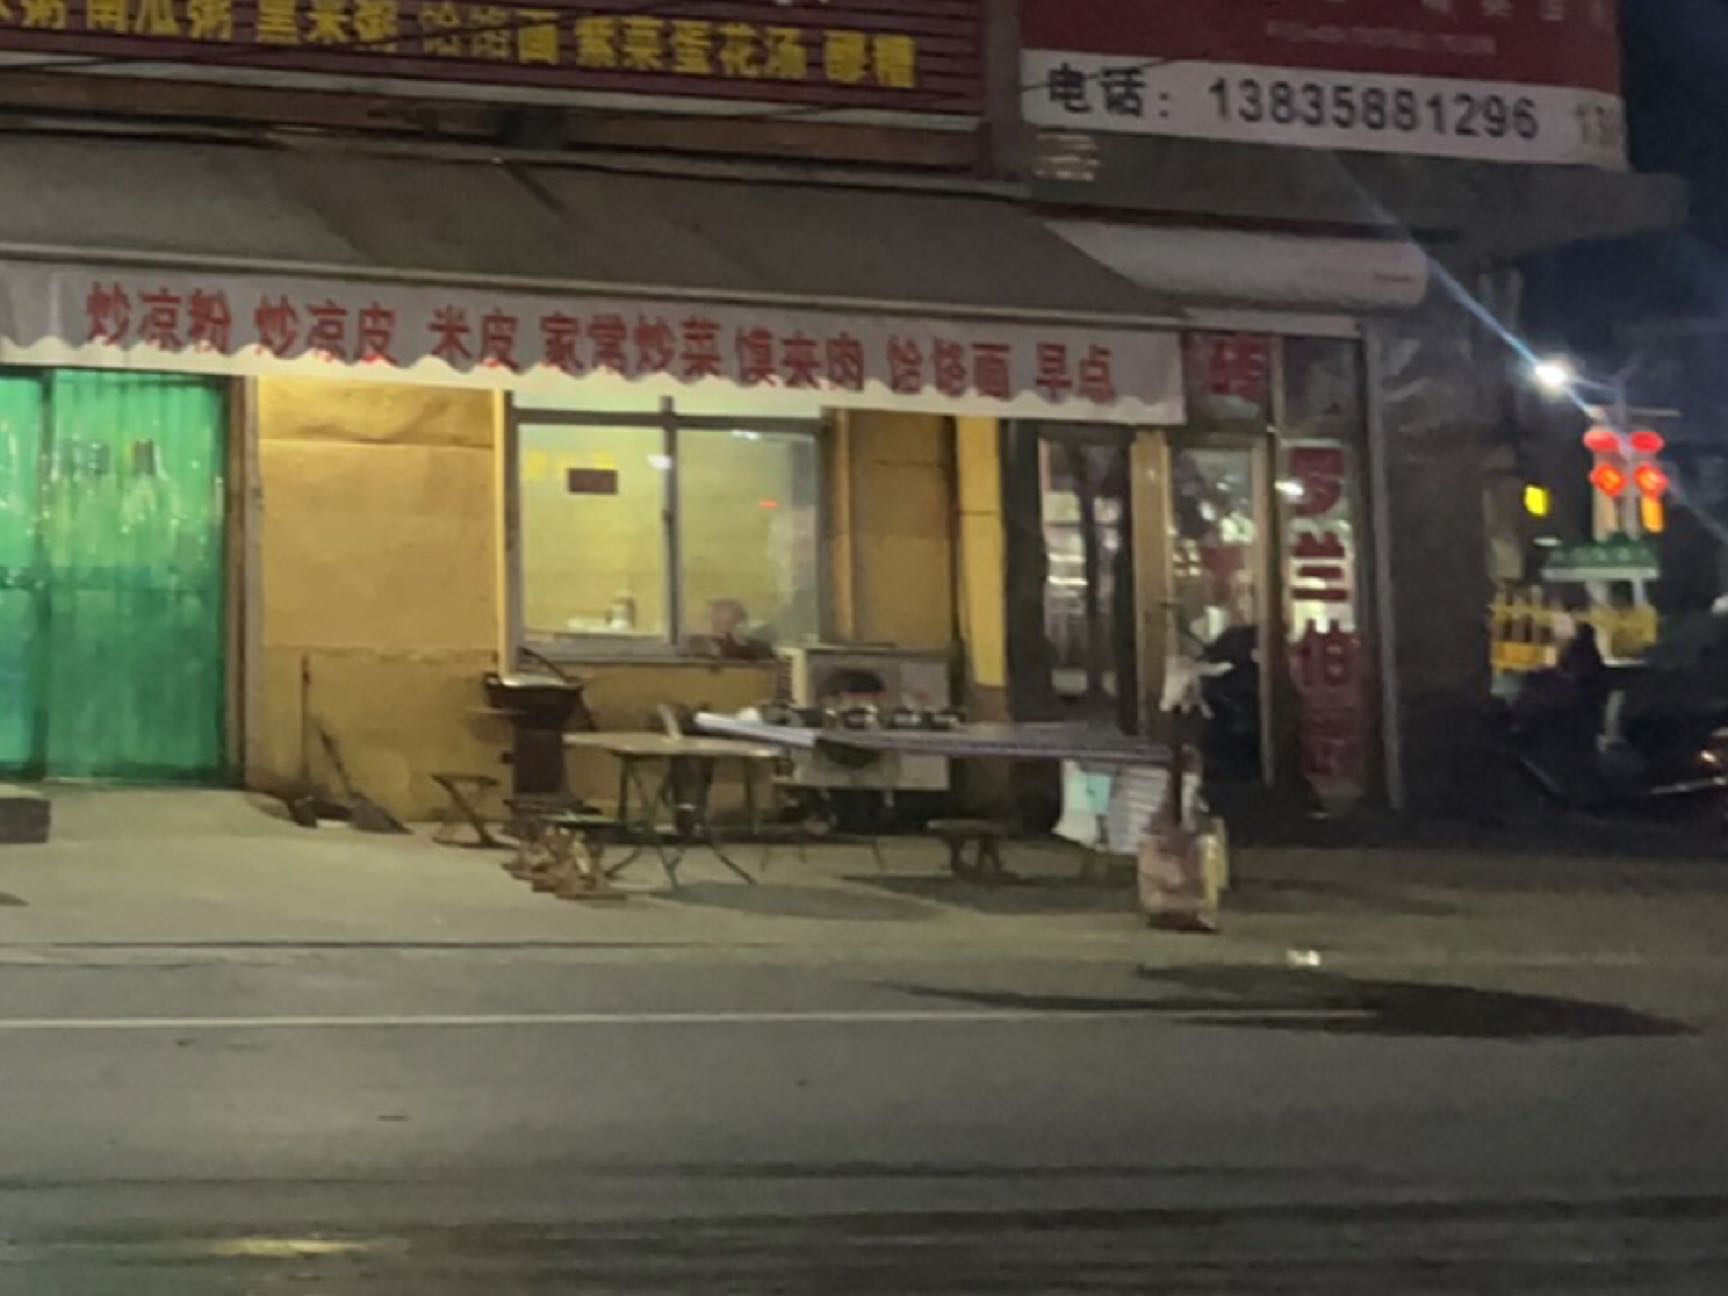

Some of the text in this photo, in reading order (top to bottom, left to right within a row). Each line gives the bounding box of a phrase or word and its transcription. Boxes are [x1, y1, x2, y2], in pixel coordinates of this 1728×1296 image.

[1208, 75, 1539, 140] 13835881296
[85, 281, 233, 356] 炒凉粉
[254, 292, 399, 367] 炒凉皮
[427, 304, 521, 375] 米皮
[537, 311, 723, 379] 家常炒菜
[1036, 342, 1116, 405] 早点
